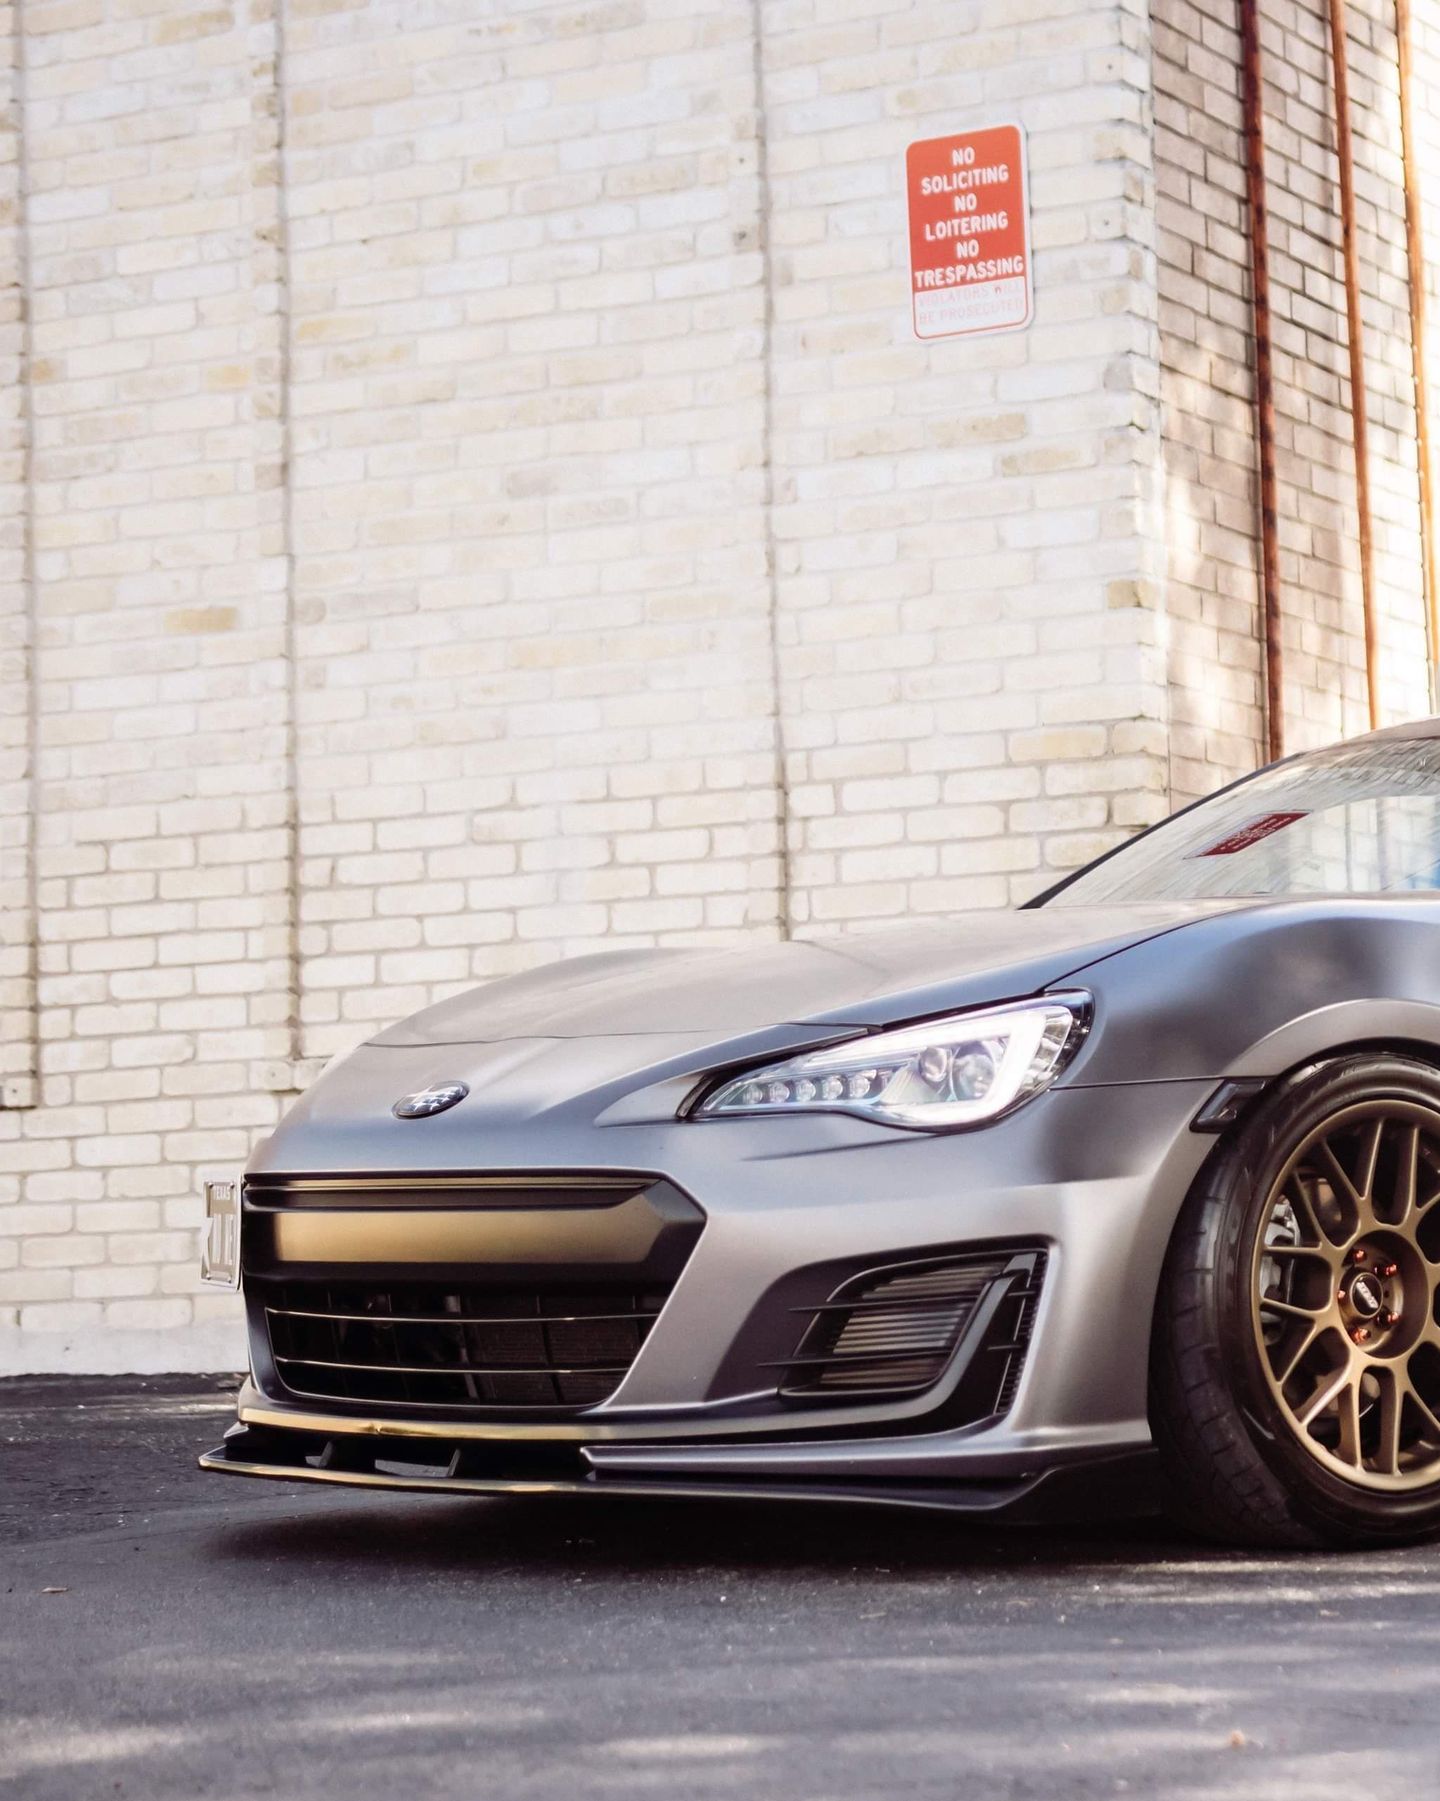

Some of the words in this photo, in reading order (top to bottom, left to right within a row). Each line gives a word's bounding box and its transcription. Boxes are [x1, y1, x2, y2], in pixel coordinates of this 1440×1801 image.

[952, 147, 975, 166] NO
[920, 164, 1010, 195] SOLICITING
[954, 193, 977, 212] NO
[924, 211, 1009, 242] LOITERING
[956, 239, 979, 259] NO
[914, 255, 1024, 289] TRESPASSING
